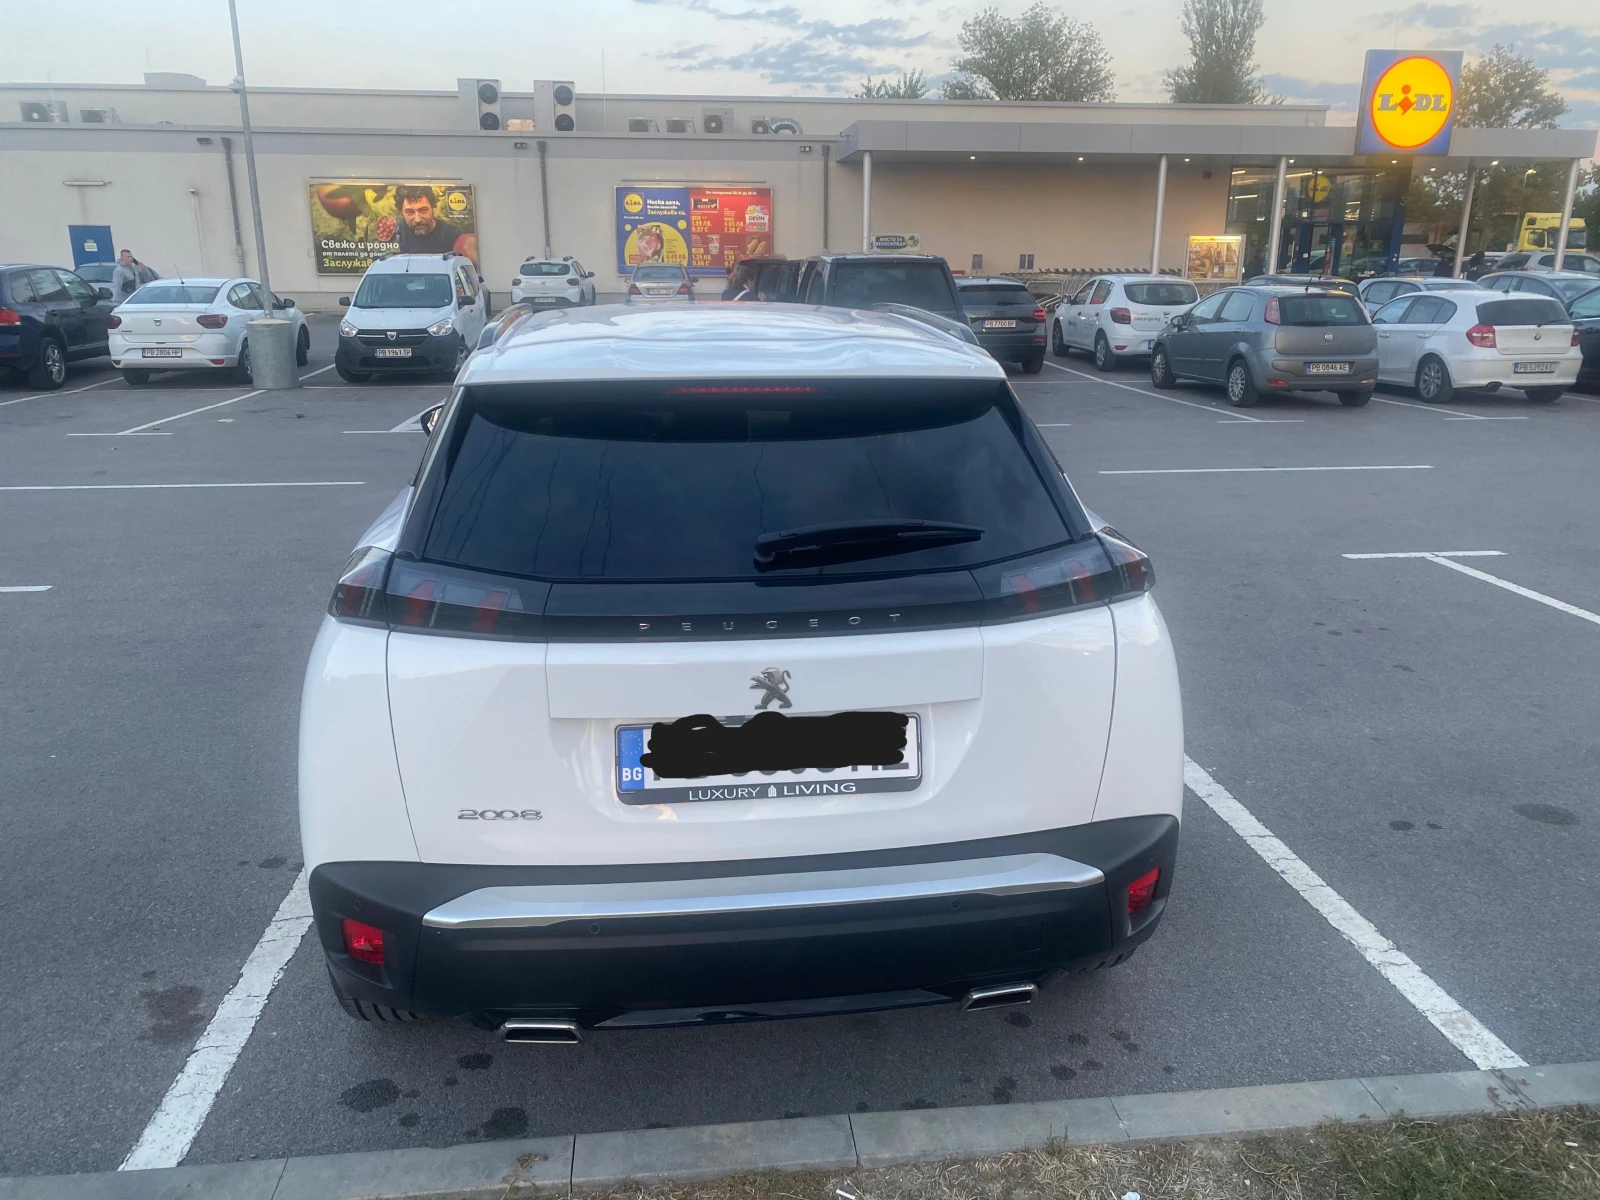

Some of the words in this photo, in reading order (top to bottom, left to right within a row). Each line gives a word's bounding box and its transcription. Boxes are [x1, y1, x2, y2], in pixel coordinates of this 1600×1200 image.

[321, 239, 356, 249] Свежо
[367, 242, 399, 251] родно
[1321, 363, 1337, 371] 0846
[639, 613, 900, 631] PEUGEOT
[622, 767, 642, 781] BG
[689, 787, 760, 801] LUXURY
[783, 782, 856, 796] LIVING
[457, 809, 542, 820] 2008
